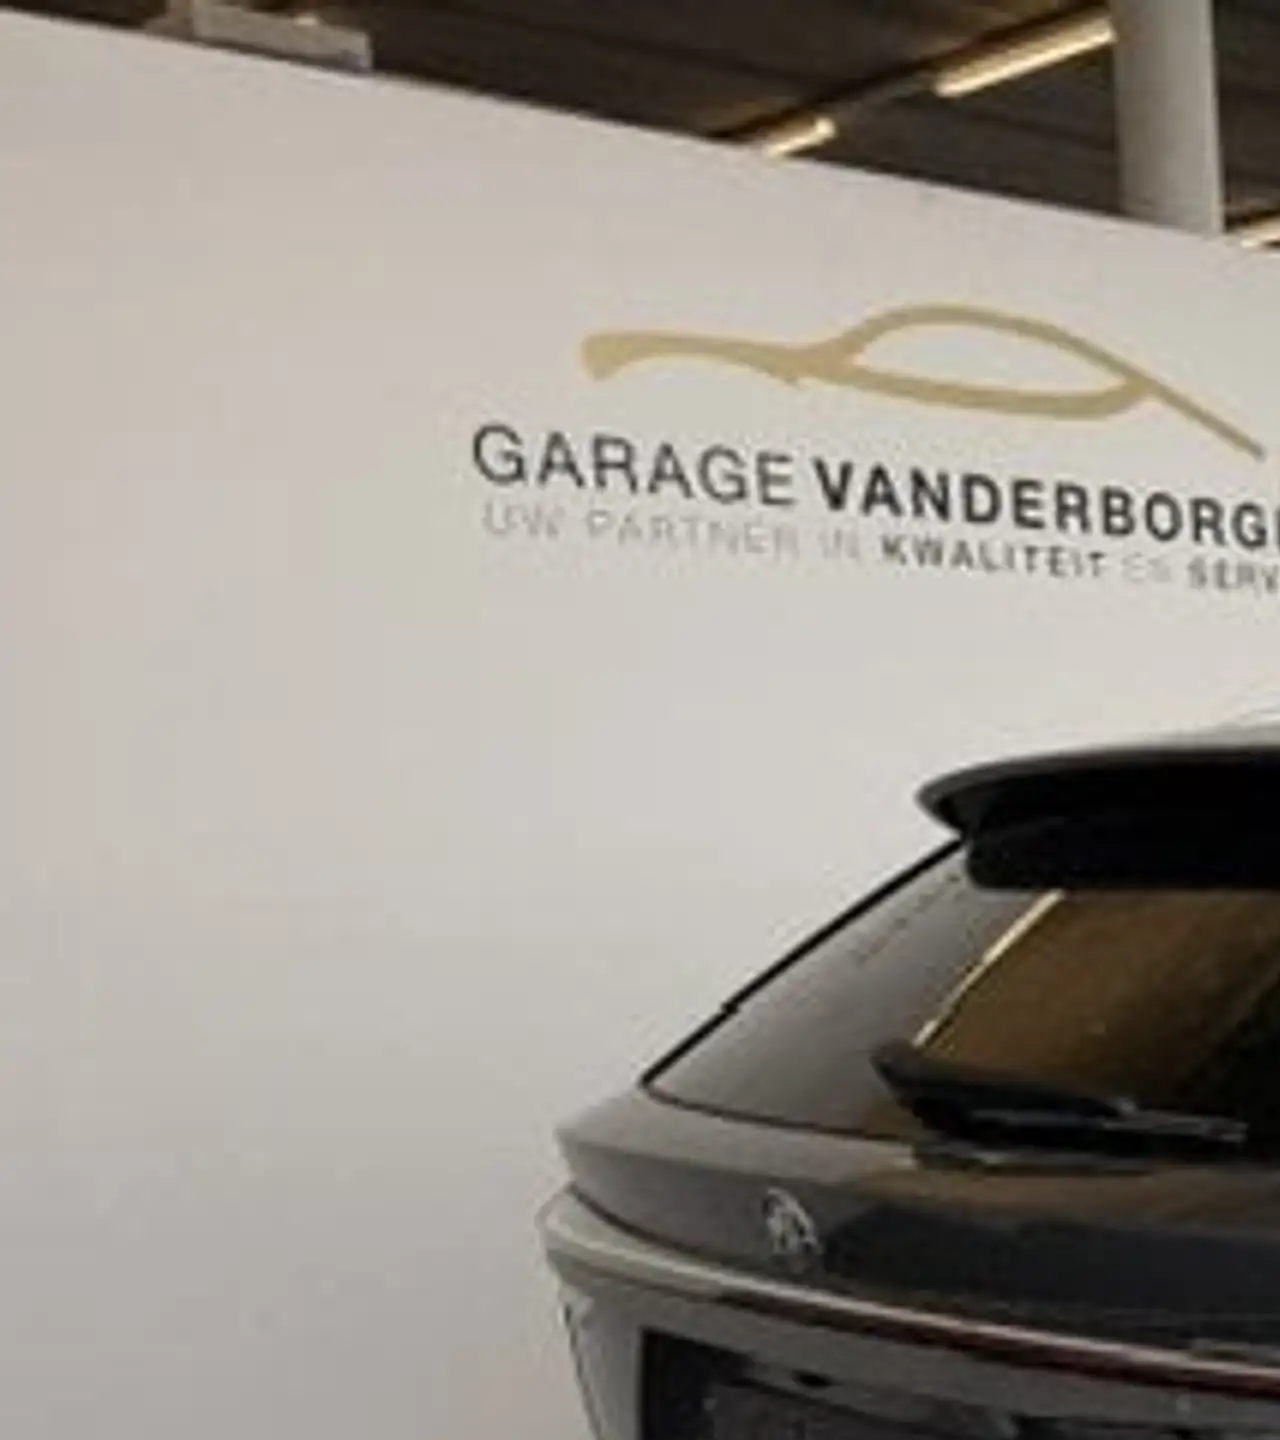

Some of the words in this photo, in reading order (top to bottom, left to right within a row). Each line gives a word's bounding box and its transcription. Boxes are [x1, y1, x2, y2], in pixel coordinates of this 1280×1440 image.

[470, 422, 795, 506] GARAGE
[586, 507, 799, 561] PARTNER
[880, 535, 1105, 578] KWALITEIT
